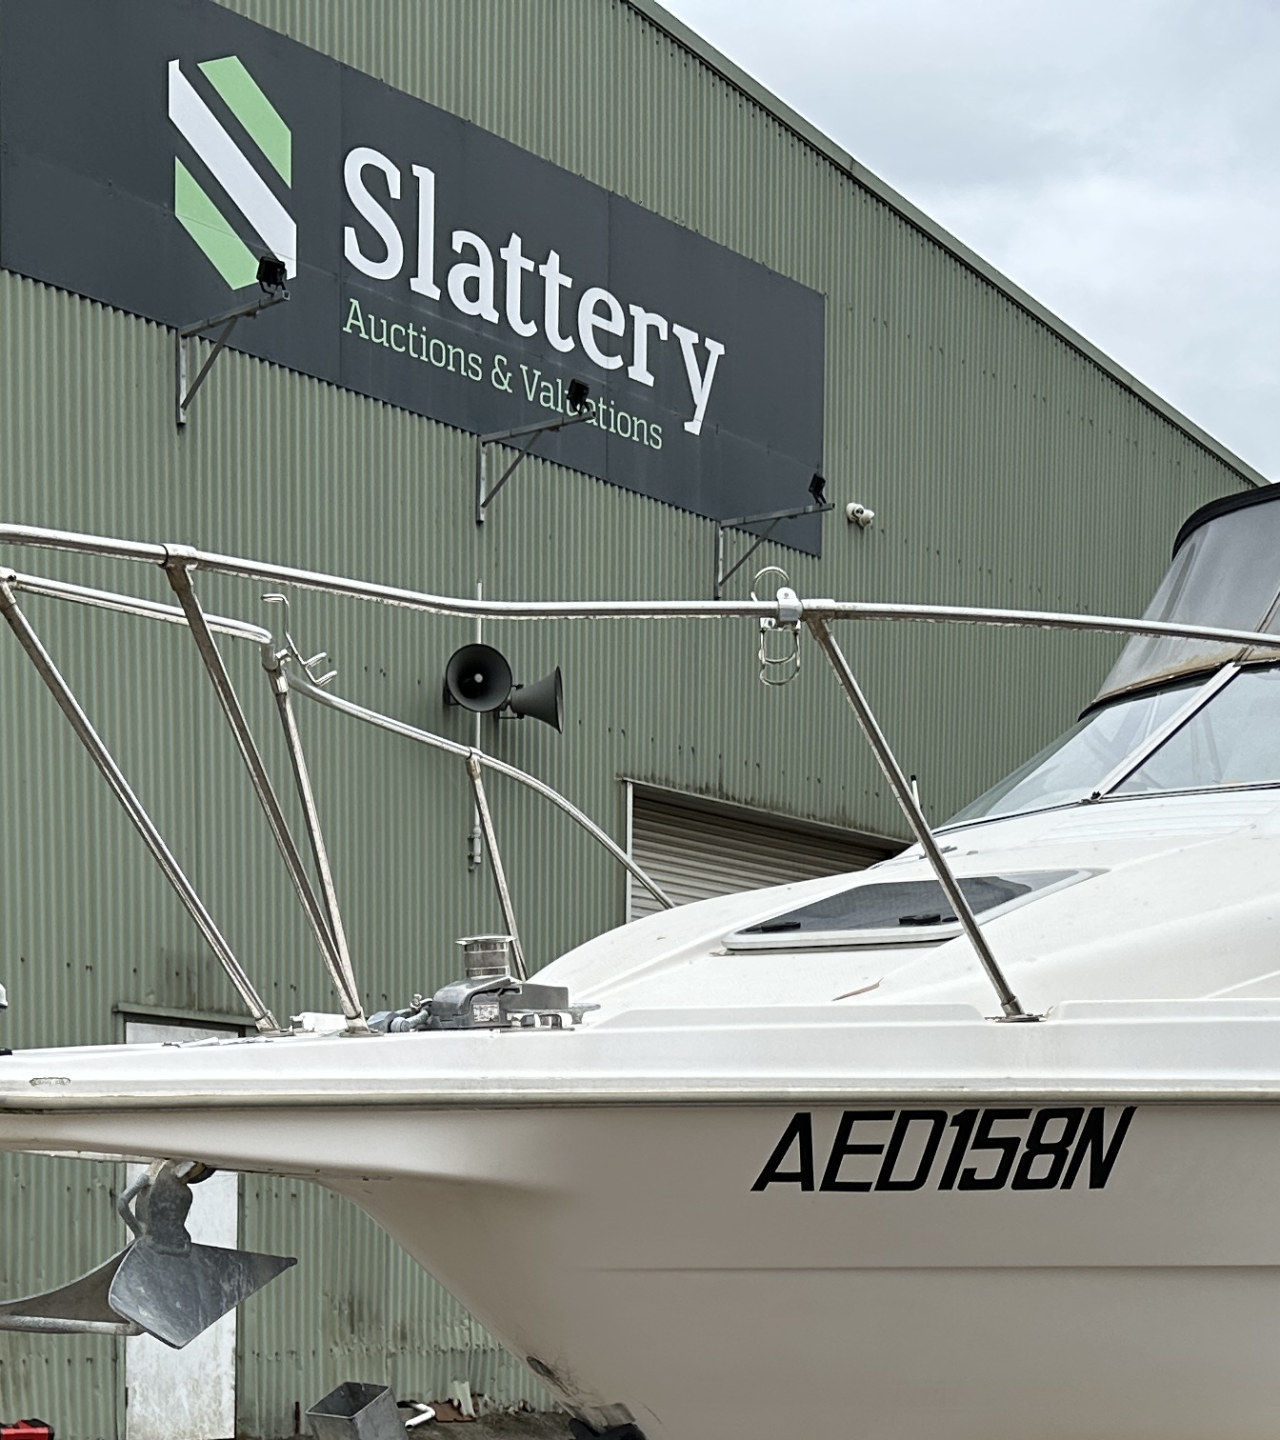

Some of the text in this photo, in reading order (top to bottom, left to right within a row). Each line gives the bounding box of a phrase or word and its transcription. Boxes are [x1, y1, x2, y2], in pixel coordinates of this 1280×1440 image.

[344, 146, 725, 435] Slattery
[342, 297, 483, 381] Auctions
[491, 354, 513, 393] &
[750, 1105, 1137, 1193] AED158N
